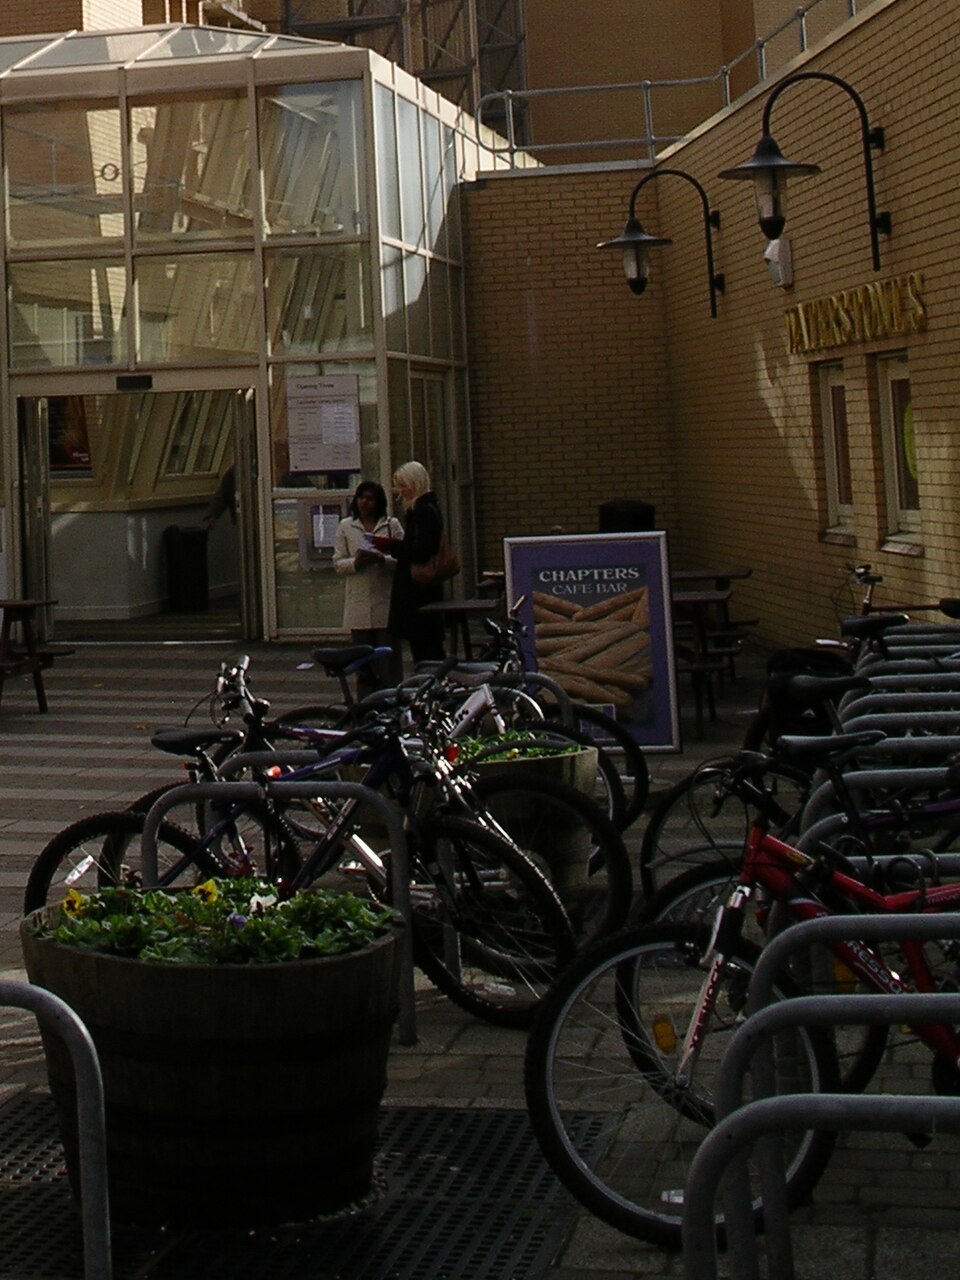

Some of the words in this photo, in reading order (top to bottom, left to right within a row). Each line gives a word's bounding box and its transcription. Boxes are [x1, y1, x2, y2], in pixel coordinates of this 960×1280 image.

[296, 383, 318, 391] Opening
[539, 567, 640, 583] CHAPTERS
[551, 583, 593, 596] CAFE
[596, 582, 628, 594] BAR
